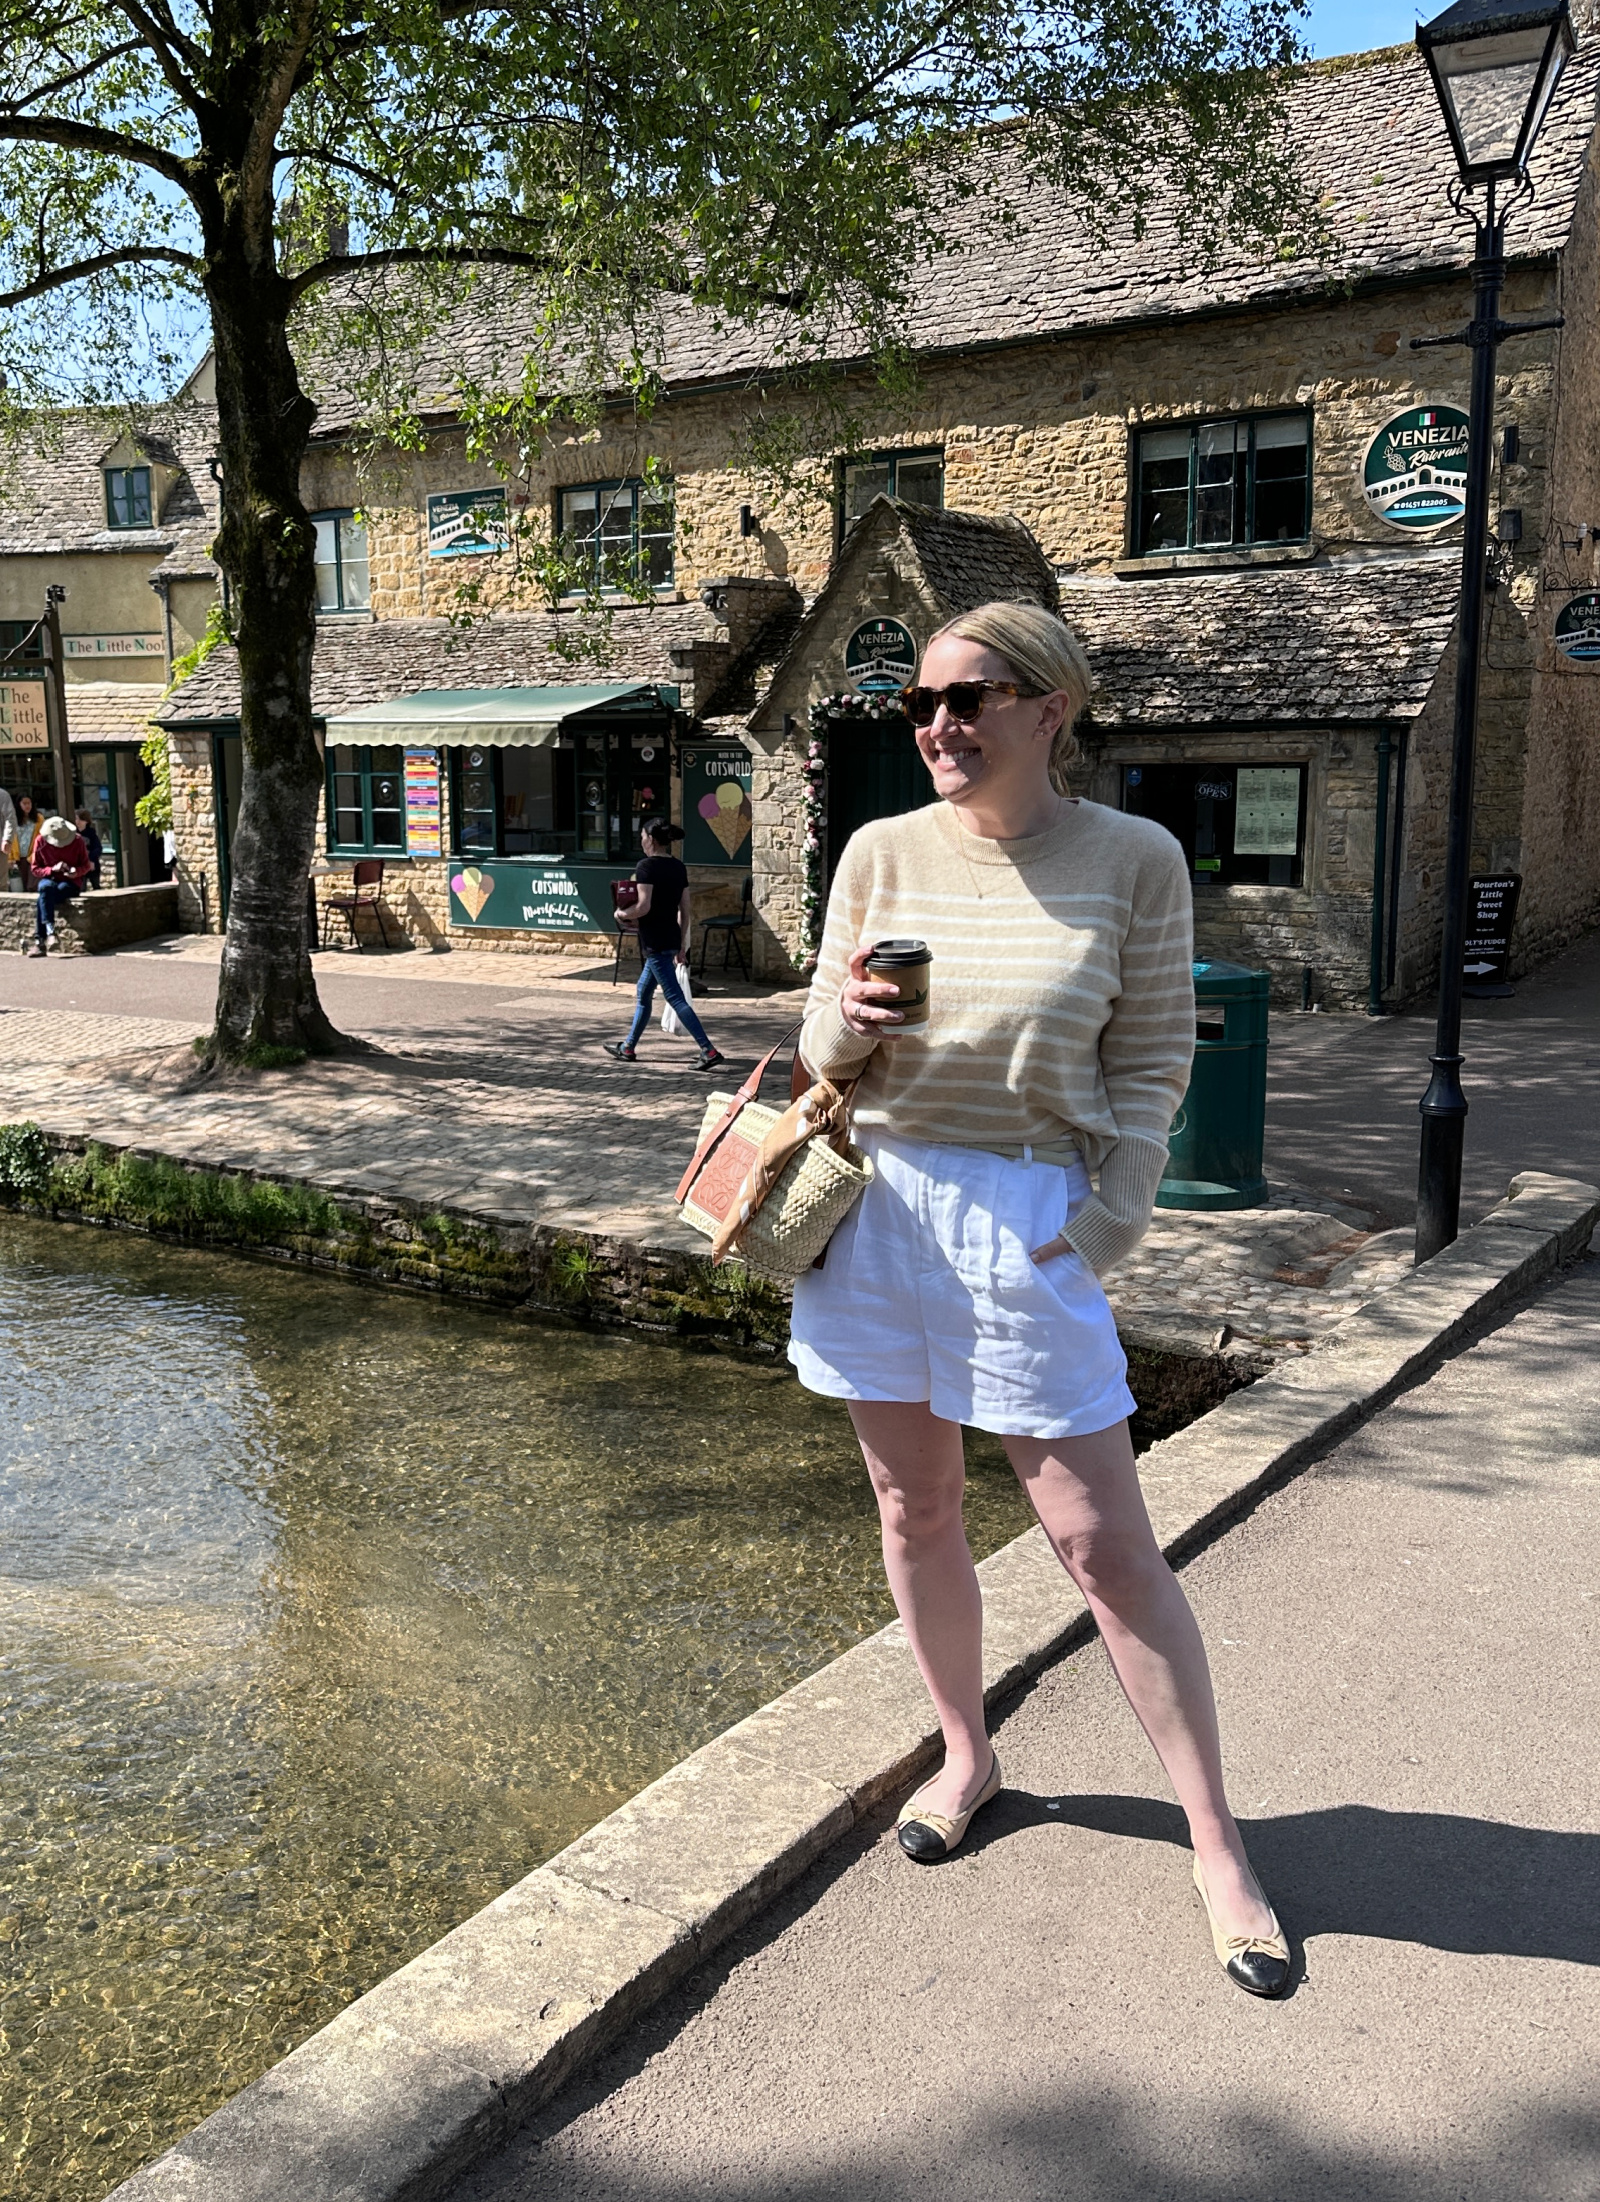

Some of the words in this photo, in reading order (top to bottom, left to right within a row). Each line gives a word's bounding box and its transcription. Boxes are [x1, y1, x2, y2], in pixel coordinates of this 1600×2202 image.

[1388, 425, 1469, 447] VENEZIA
[1569, 606, 1600, 616] VENE
[858, 632, 905, 645] VENEZIA
[66, 640, 93, 652] The
[96, 639, 132, 652] Little
[0, 687, 30, 703] The
[0, 708, 44, 725] Little
[0, 727, 43, 744] Nook
[705, 761, 752, 777] COTSWOLD
[1198, 786, 1228, 798] OPEN
[531, 880, 579, 896] COTSWOLDS
[1473, 880, 1514, 889] Bourton's
[1480, 891, 1503, 899] Little
[1476, 901, 1503, 909] Sweet
[1477, 911, 1499, 920] Shop
